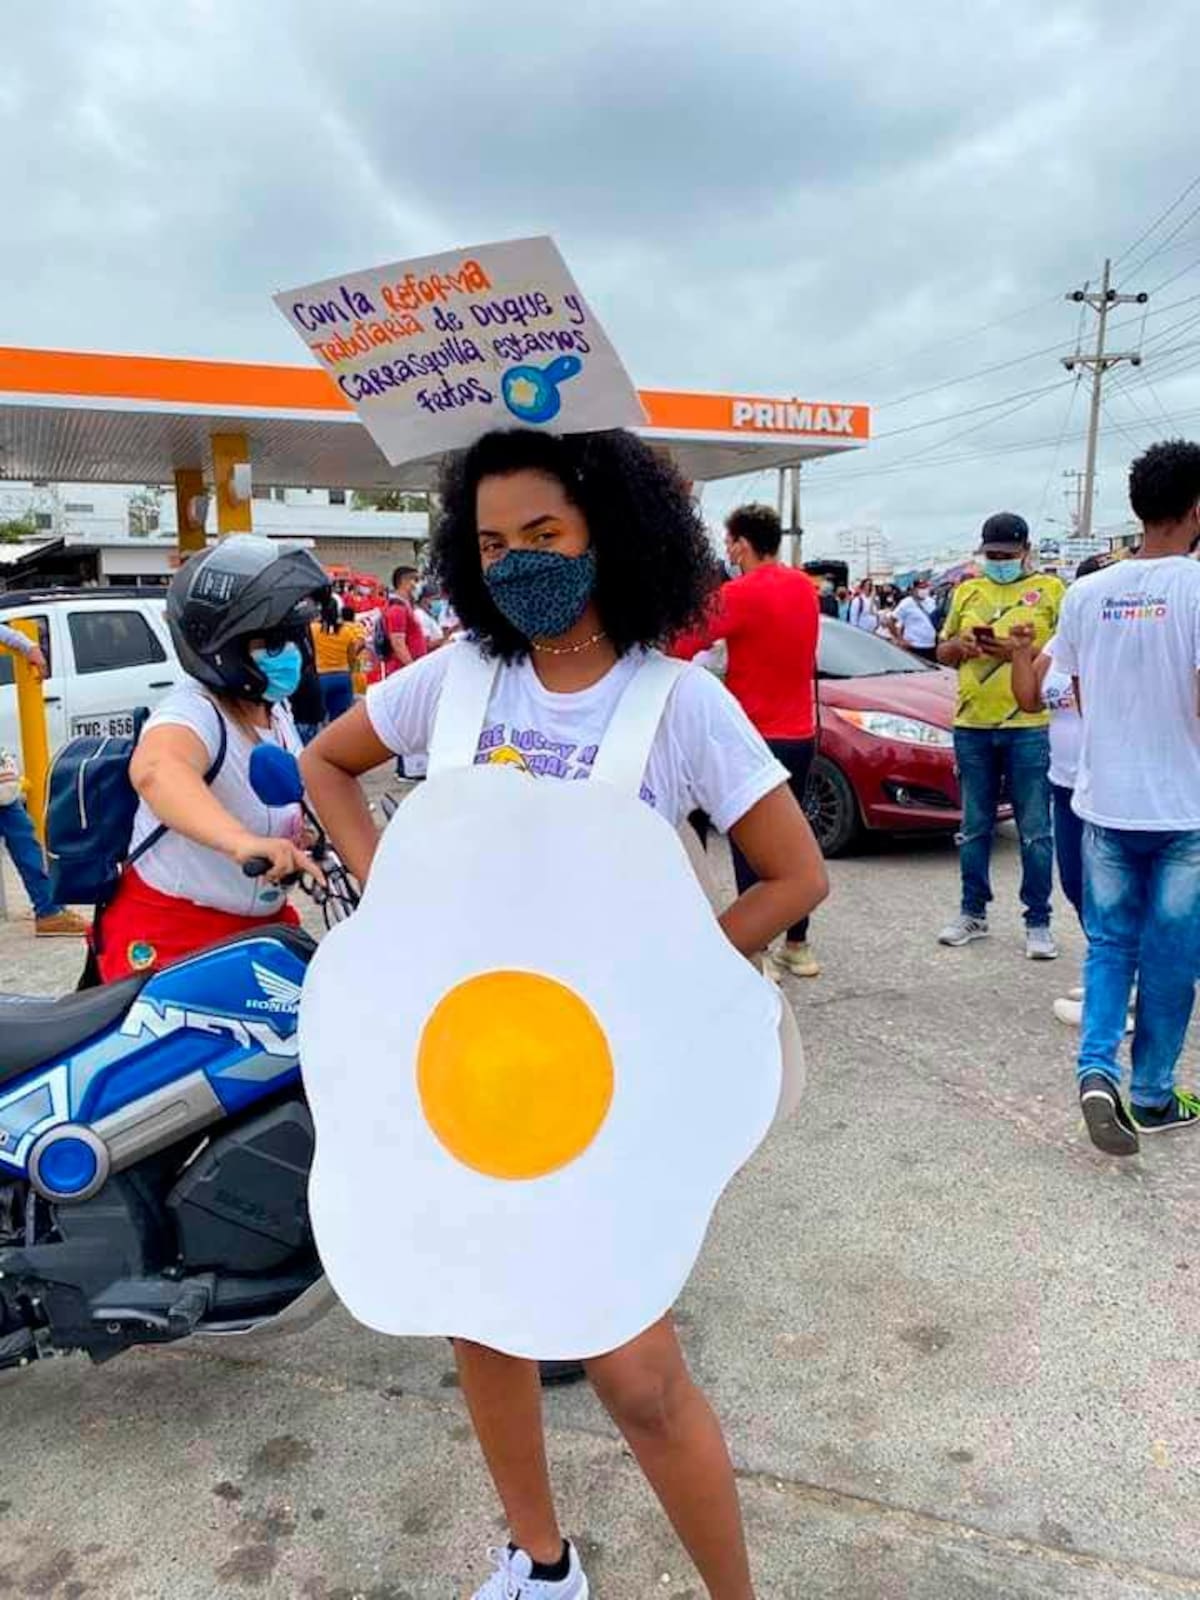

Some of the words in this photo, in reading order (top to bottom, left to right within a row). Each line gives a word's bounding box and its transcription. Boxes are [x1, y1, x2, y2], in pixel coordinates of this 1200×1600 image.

[434, 306, 464, 334] de
[564, 293, 586, 325] y
[732, 400, 853, 433] PRIMAX
